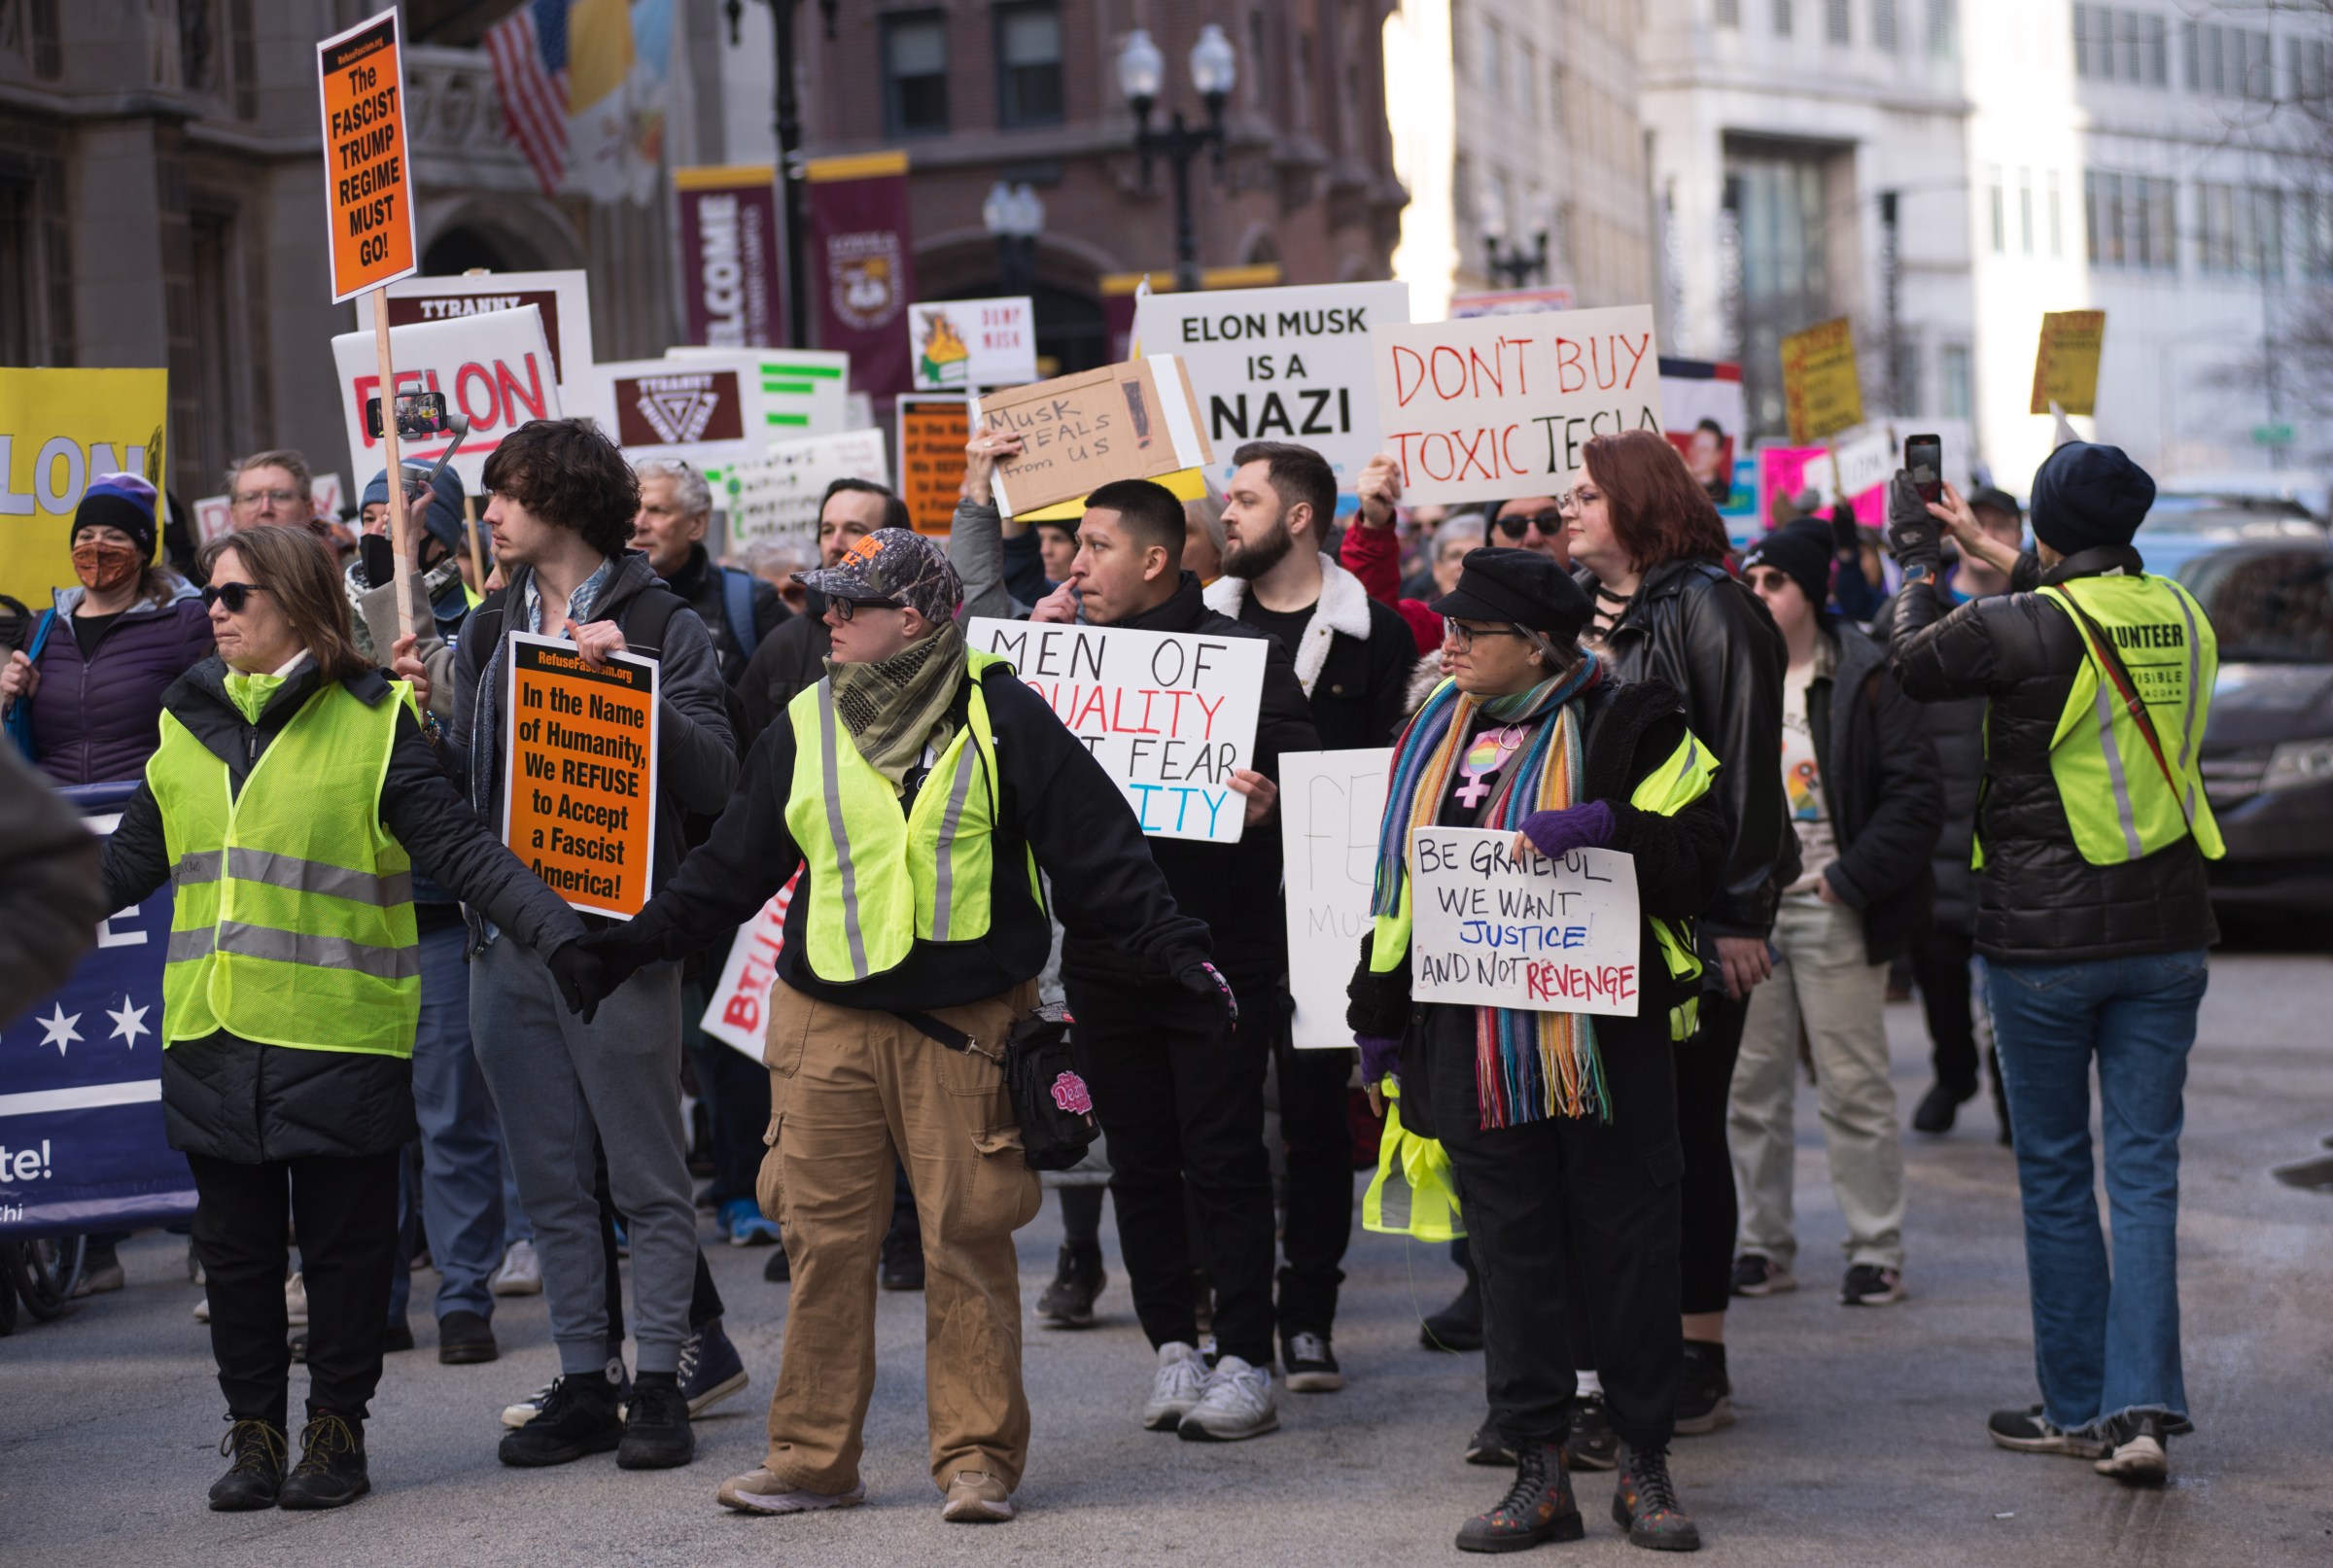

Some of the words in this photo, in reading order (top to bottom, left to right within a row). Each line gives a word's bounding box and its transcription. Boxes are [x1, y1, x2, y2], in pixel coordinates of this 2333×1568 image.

[348, 65, 377, 96] The
[331, 86, 397, 139] FASCIST
[339, 123, 395, 170] TRUMP
[338, 157, 400, 207] REGIME
[349, 193, 395, 237] MUST
[360, 232, 389, 266] GO!
[420, 296, 521, 319] TYRANNY
[1181, 313, 1267, 343] ELON
[1277, 307, 1368, 337] MUSK
[1247, 355, 1275, 381] IS
[1285, 353, 1307, 379] A
[1392, 335, 1534, 407] DON'T
[1555, 332, 1650, 394] BUY
[1019, 414, 1110, 455] TEALS
[1210, 388, 1350, 440] NAZI
[1004, 458, 1053, 478] from
[1388, 424, 1529, 488] TOXIC
[2107, 624, 2184, 649] LUNTEER
[538, 650, 633, 683] RefuseFassm.org
[991, 629, 1106, 681] MEN
[1151, 638, 1228, 689] OF
[523, 681, 543, 710] In
[550, 686, 582, 716] the
[589, 693, 644, 729] Name
[519, 718, 540, 744] of
[546, 720, 646, 770] Humanity,
[1129, 738, 1237, 784] FEAR
[525, 751, 555, 781] We
[562, 758, 639, 798] REFUSE
[533, 788, 552, 816] to
[557, 793, 629, 833] Accept
[1129, 784, 1228, 838] ITY
[532, 827, 544, 850] a
[550, 826, 625, 865] Fascist
[1418, 839, 1459, 875] BE
[531, 858, 621, 900] America!
[1438, 886, 1489, 917] WE
[1499, 888, 1583, 921] WANT
[1421, 952, 1471, 987] AND
[1478, 951, 1530, 988] NOT
[1526, 960, 1637, 1006] REVENGE
[0, 1139, 52, 1183] te!
